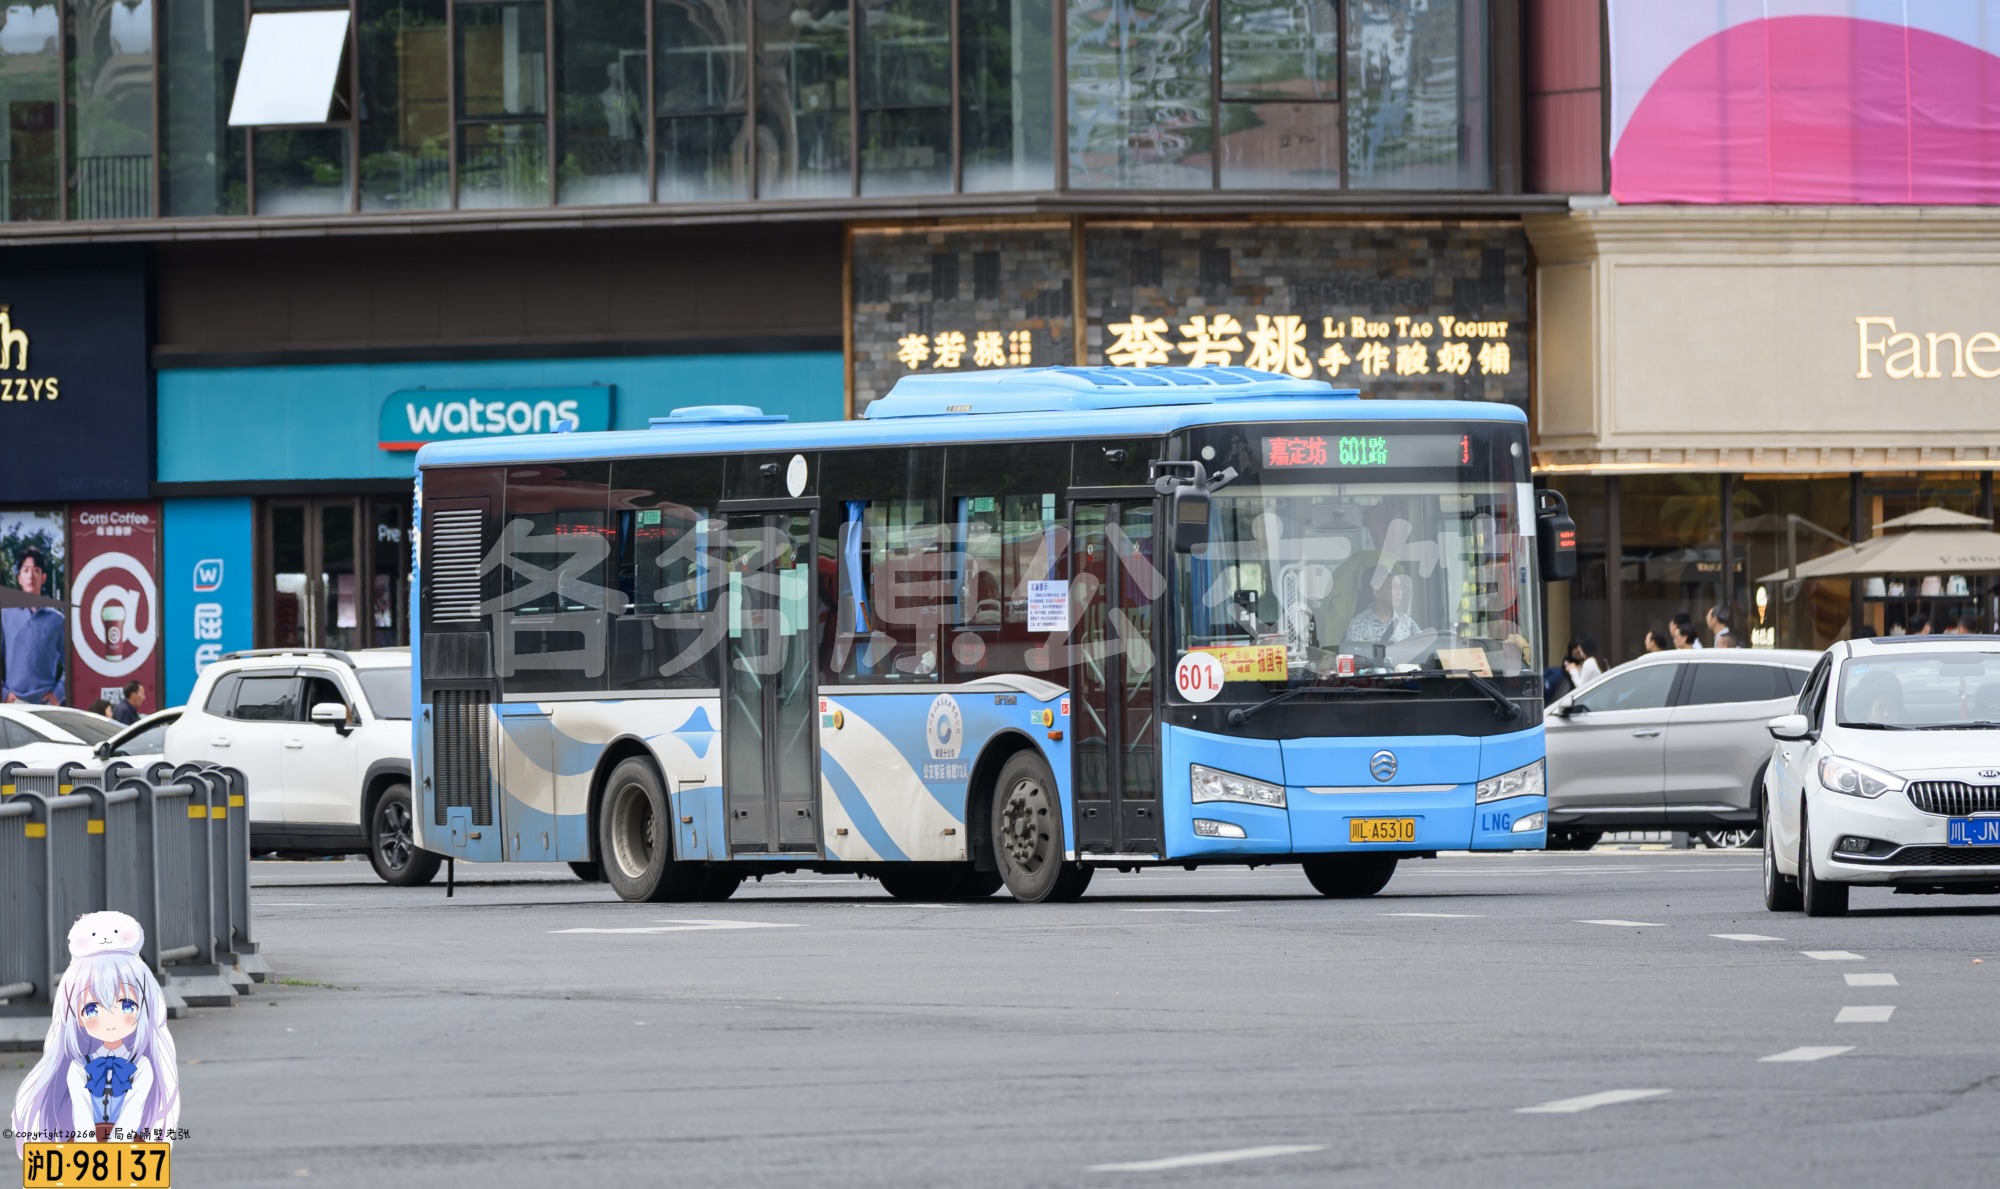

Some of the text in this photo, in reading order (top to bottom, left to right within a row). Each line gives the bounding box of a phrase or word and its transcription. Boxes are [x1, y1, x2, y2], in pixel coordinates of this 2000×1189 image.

[1104, 313, 1313, 379] 李若桃
[1318, 341, 1510, 377] 手作酸奶铺
[1855, 316, 2000, 379] Fane
[406, 398, 579, 434] watsons
[1269, 436, 1388, 466] 嘉定坊 601路
[80, 511, 149, 525] Cotti Coffee
[1482, 813, 1510, 831] LNG
